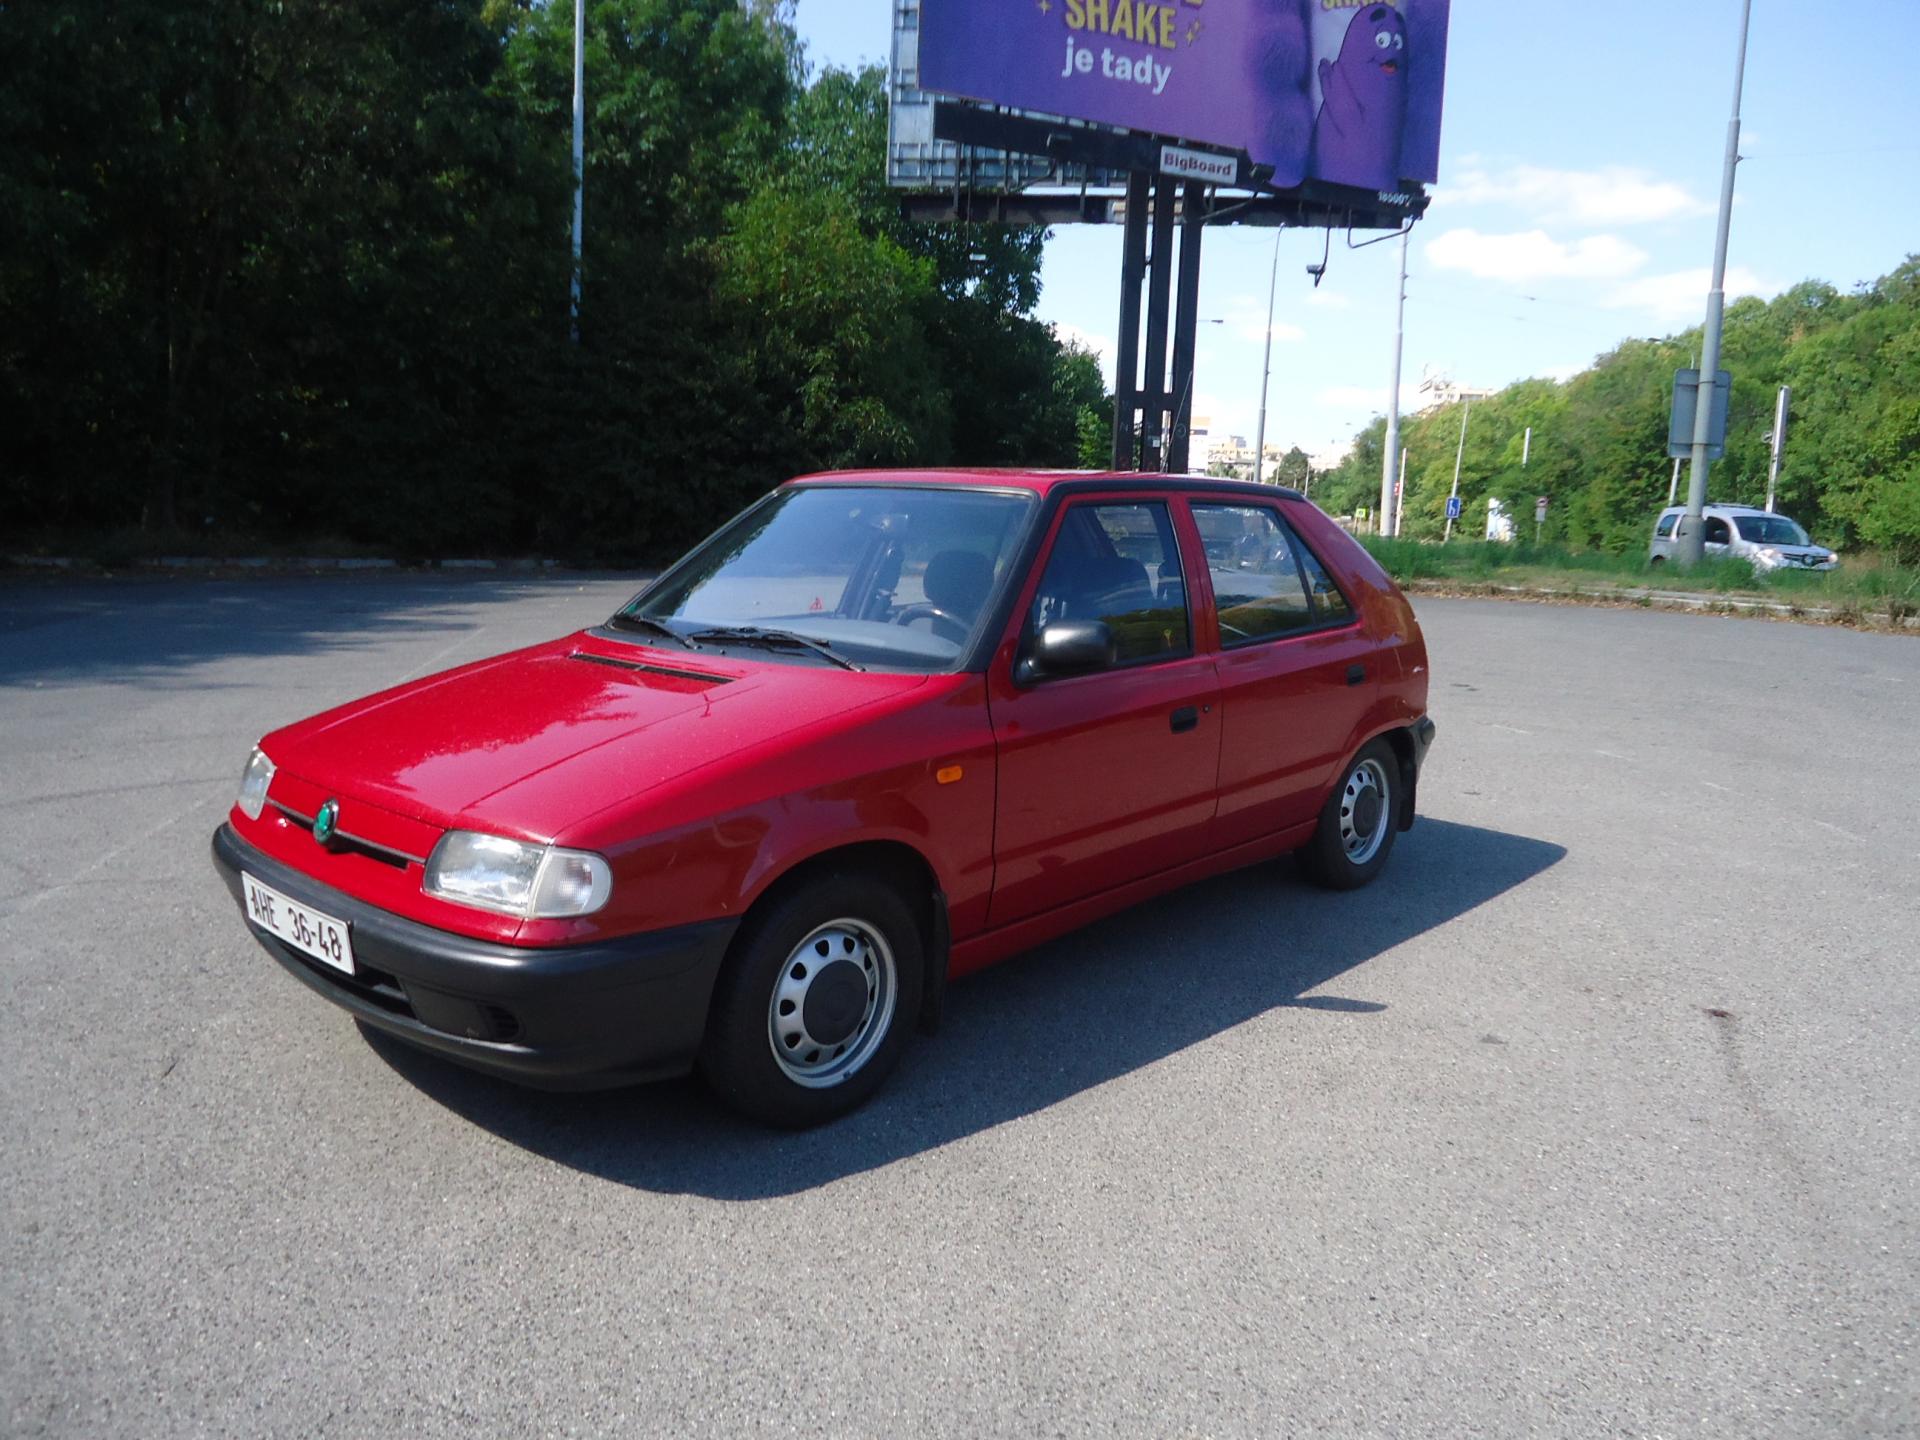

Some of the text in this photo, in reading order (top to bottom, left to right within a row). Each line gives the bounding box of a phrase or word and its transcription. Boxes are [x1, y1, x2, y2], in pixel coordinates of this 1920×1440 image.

[1065, 0, 1177, 49] SHAKE
[1061, 35, 1172, 95] je tady
[1164, 152, 1232, 175] BigBoard
[251, 885, 342, 961] AHE 36-48
